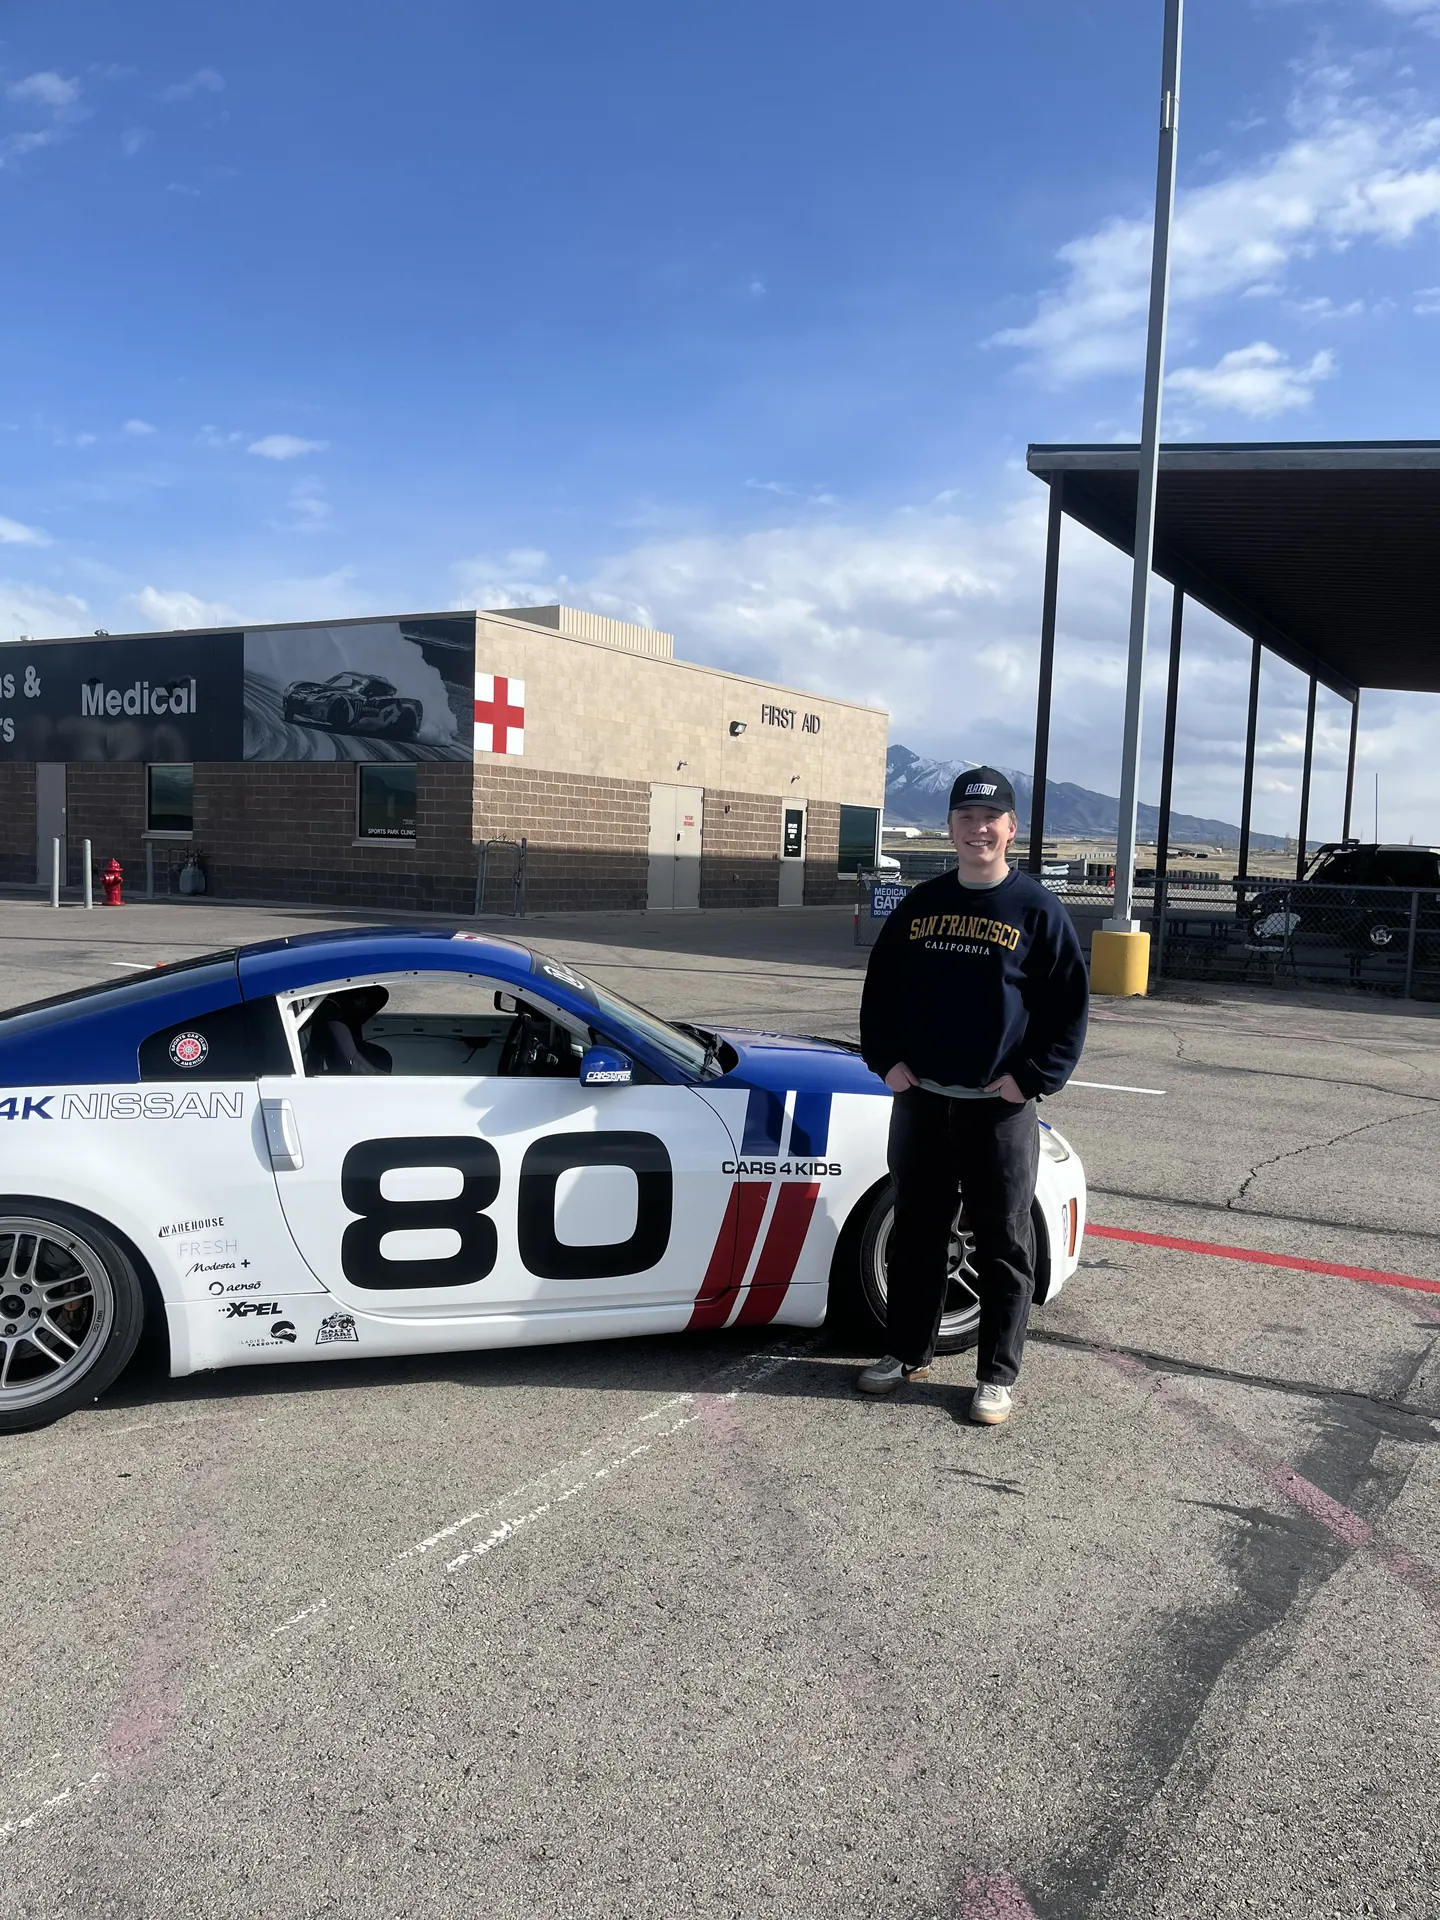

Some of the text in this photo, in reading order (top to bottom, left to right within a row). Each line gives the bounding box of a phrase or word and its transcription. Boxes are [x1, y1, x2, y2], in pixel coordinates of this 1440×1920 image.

[82, 679, 196, 716] Medical
[762, 704, 820, 734] FIRST AID
[874, 896, 905, 910] GAT
[910, 915, 1020, 951] SAN FRANCISCO
[925, 941, 990, 955] CALIFORNIA
[61, 1092, 243, 1119] NISSAN
[341, 1131, 673, 1290] 80
[162, 1217, 224, 1235] WAREHOUSE
[179, 1239, 237, 1257] FRESH
[185, 1262, 236, 1277] Modesta
[226, 1302, 283, 1318] XPEL
